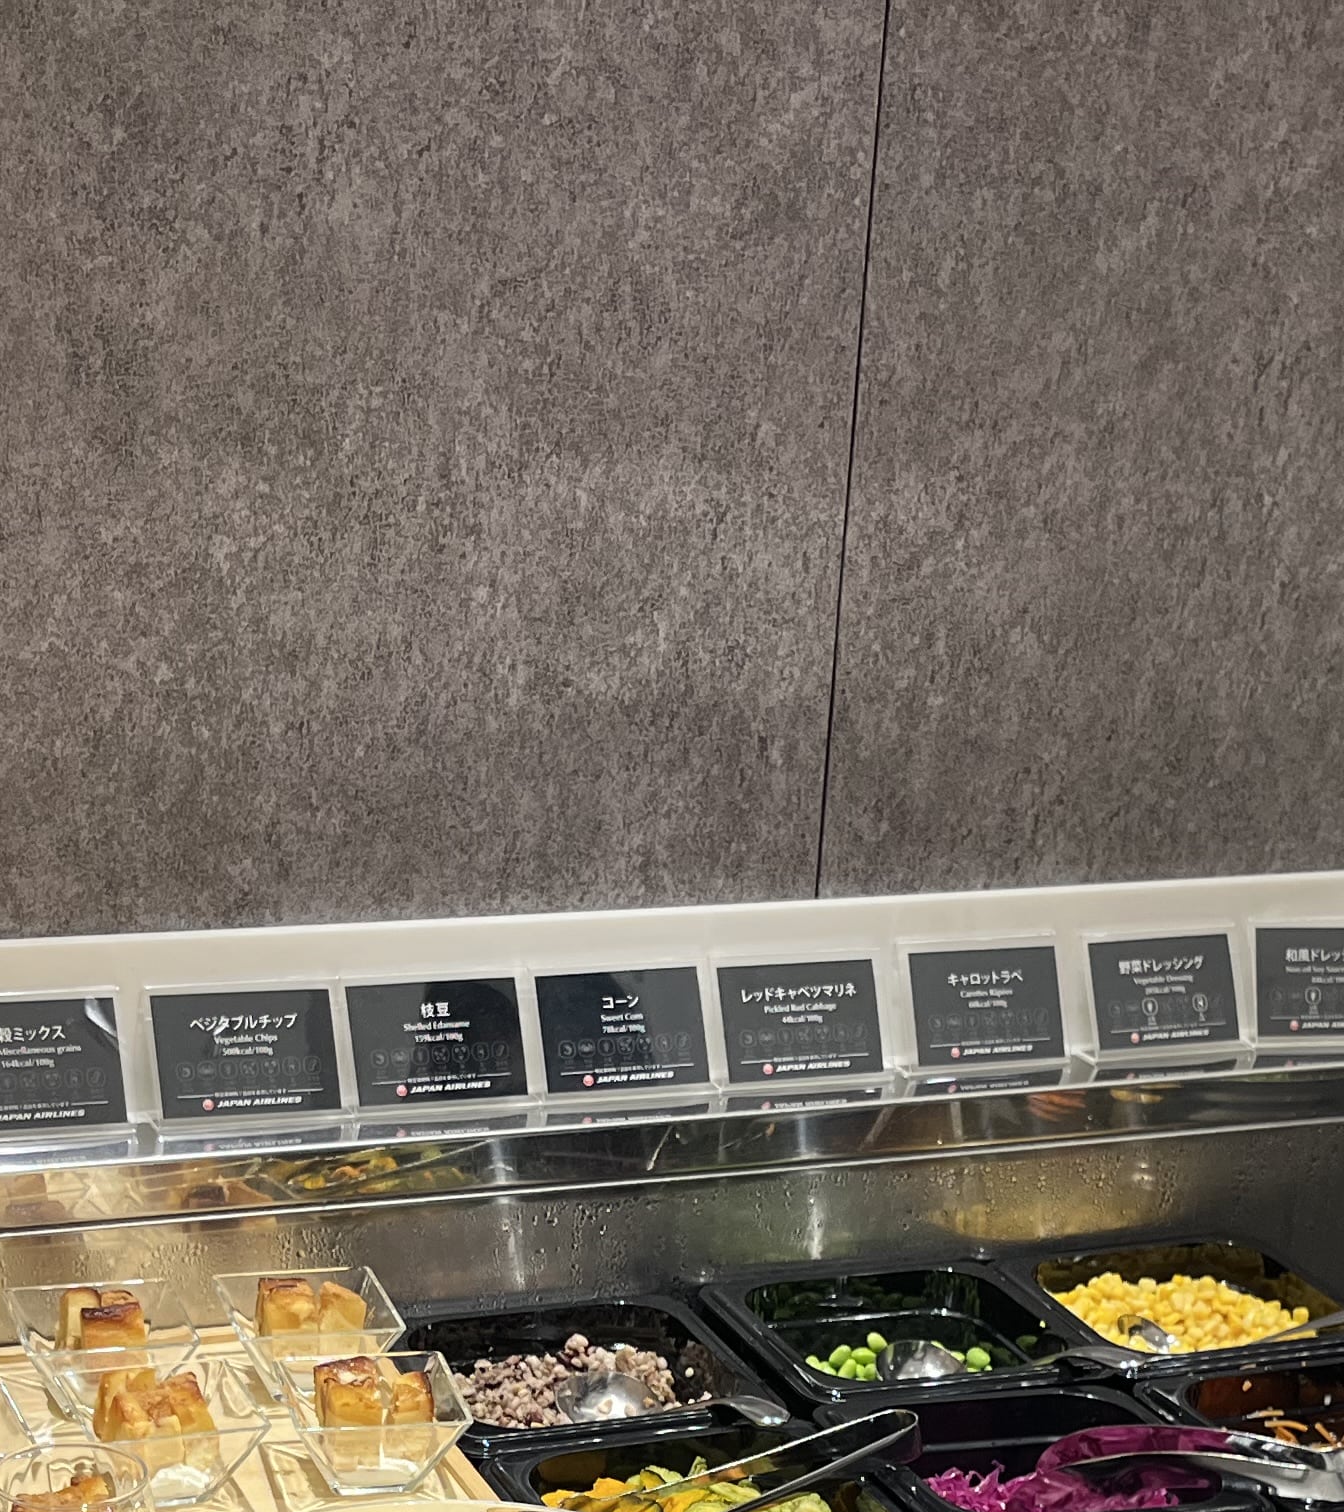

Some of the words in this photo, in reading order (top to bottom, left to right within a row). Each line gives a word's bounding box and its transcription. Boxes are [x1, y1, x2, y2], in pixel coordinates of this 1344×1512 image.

[1118, 955, 1204, 975] 野菜ドレッシング
[947, 970, 1024, 987] キャロットラペ
[741, 983, 857, 1003] レッドキャベツマリネ
[602, 994, 639, 1009] コーン
[420, 1002, 451, 1018] 枝豆
[190, 1012, 298, 1032] ベジタブルチップ
[600, 1014, 624, 1023] Sweet
[214, 1033, 254, 1045] Vegetable
[255, 1033, 278, 1044] Chips
[1143, 1032, 1170, 1041] JAPAN
[1171, 1029, 1210, 1039] AIRLINES
[57, 1043, 82, 1055] grains
[962, 1046, 991, 1056] JAPAN
[992, 1044, 1033, 1054] AIRLINES
[776, 1063, 806, 1073] JAPAN
[807, 1060, 851, 1071] AIRLINES
[597, 1074, 628, 1084] JAPAN
[629, 1071, 675, 1081] AIRLINES
[410, 1084, 444, 1095] JAPAN
[444, 1080, 492, 1091] AIRLINES
[217, 1099, 252, 1109] JAPAN
[253, 1096, 303, 1107] AIRLINES
[34, 1109, 86, 1120] AIRLINES
